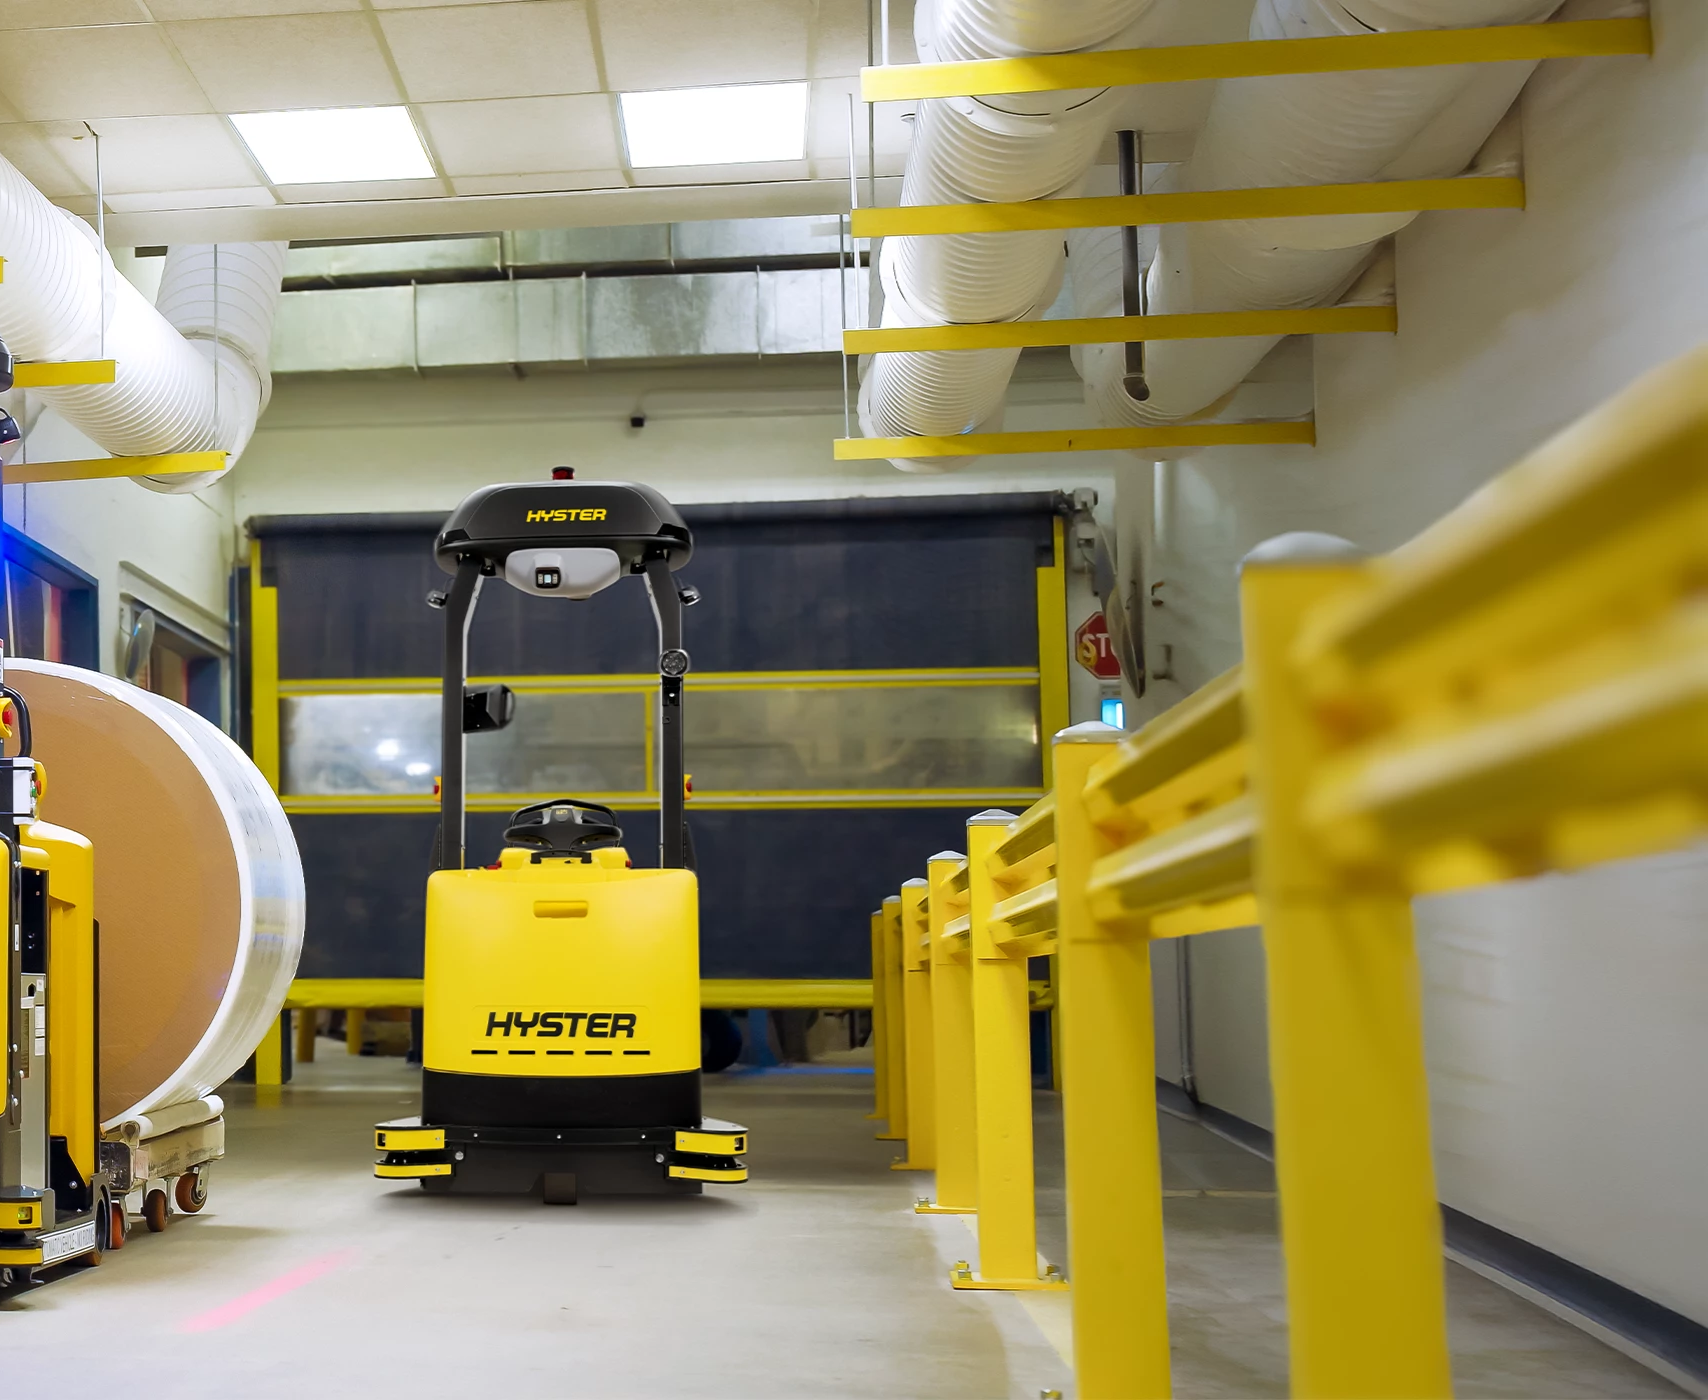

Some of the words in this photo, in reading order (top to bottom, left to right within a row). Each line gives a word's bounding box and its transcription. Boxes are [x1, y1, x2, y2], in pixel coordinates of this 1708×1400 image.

[526, 508, 607, 523] HYSTER
[1082, 633, 1115, 658] ST
[485, 1011, 637, 1039] HYSTER
